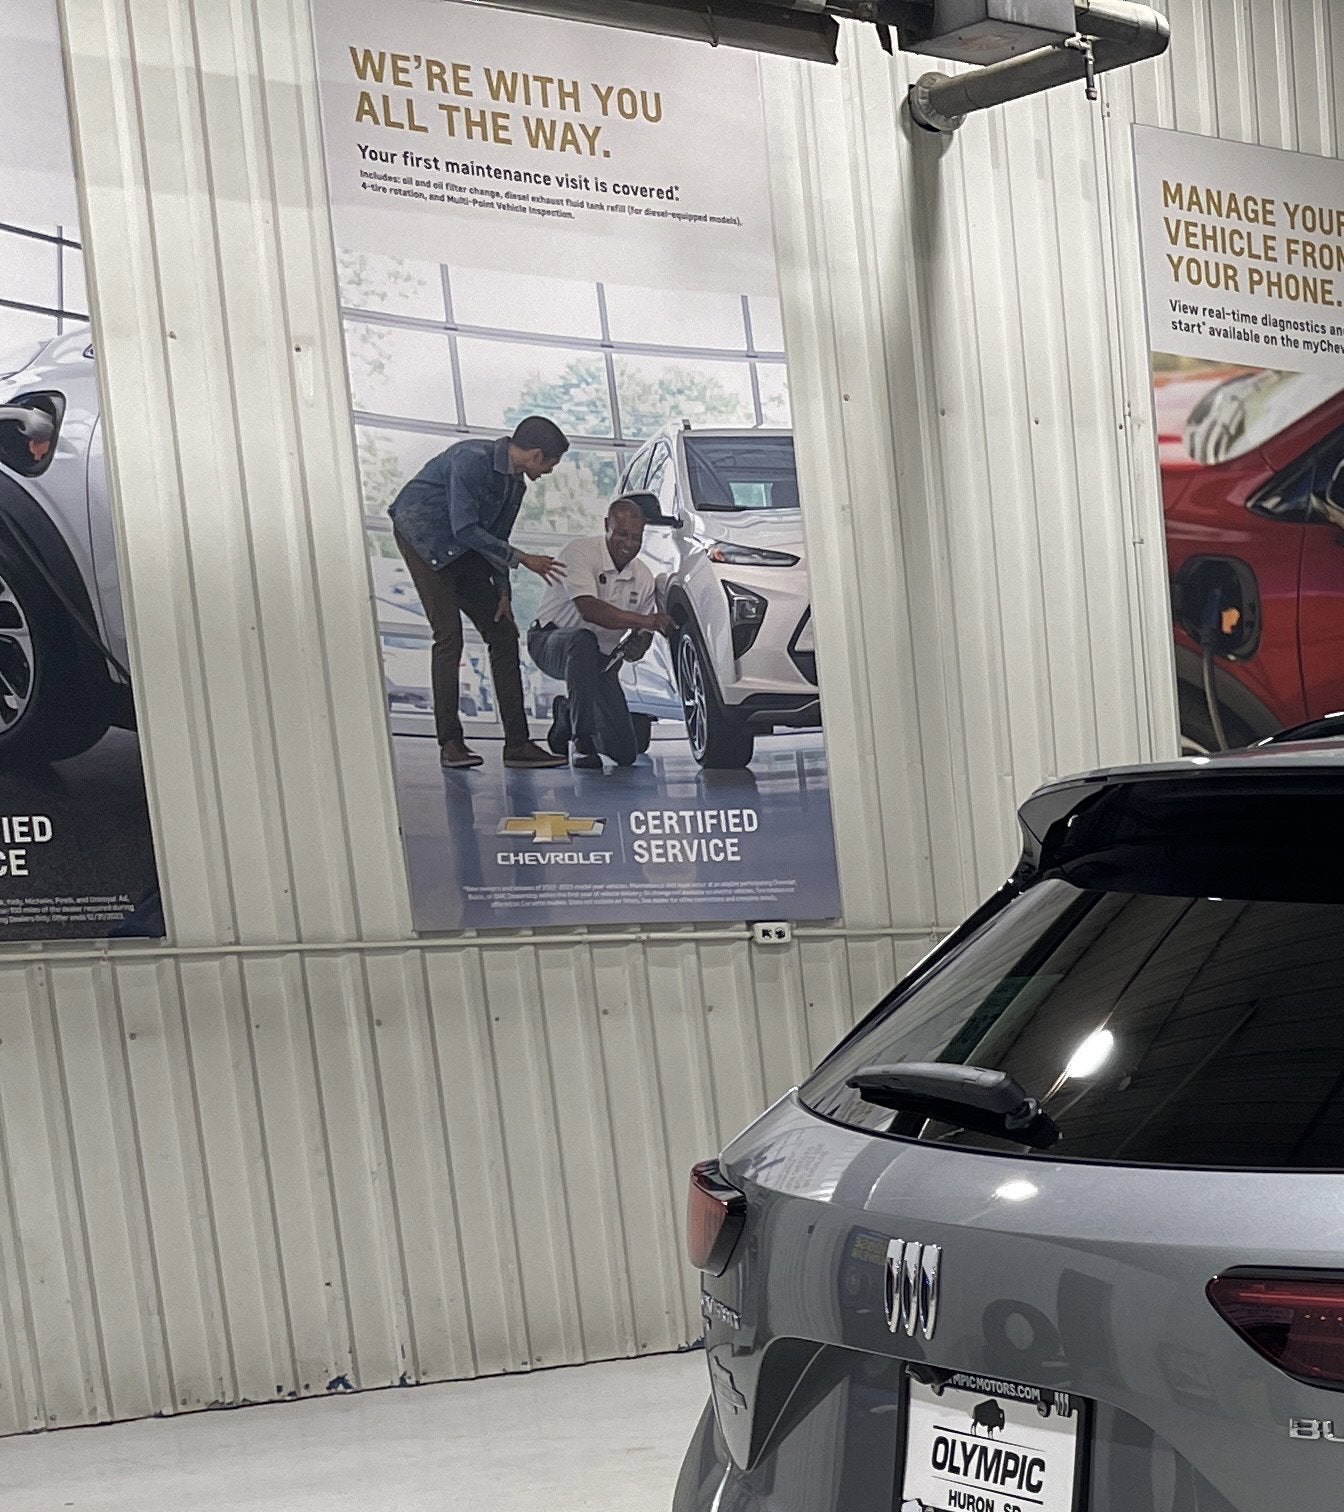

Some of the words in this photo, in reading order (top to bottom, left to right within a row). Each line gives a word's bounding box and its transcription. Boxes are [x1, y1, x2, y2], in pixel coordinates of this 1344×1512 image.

[349, 46, 474, 97] WE'RE
[483, 67, 581, 112] WITH
[591, 83, 662, 123] YOU
[355, 91, 429, 133] ALL
[438, 103, 512, 145] THE
[522, 116, 611, 158] WAY.
[357, 143, 398, 164] Your
[402, 151, 441, 171] first
[445, 161, 551, 186] maintenance
[555, 174, 590, 192] visit
[594, 177, 608, 193] is
[359, 169, 400, 183] Includes:
[402, 177, 413, 185] oil
[415, 180, 431, 188] and
[433, 182, 443, 190] oil
[445, 182, 467, 193] filter
[361, 182, 387, 194] 4-tire
[389, 188, 427, 201] rotation,
[496, 202, 527, 213] Vehicle
[1162, 179, 1276, 228] MANAGE
[1163, 216, 1278, 263] VEHICLE
[1166, 253, 1240, 293] YOUR
[1248, 267, 1343, 307] PHONE.
[1169, 299, 1199, 316] View
[1202, 306, 1258, 325] real-time
[1261, 313, 1327, 335] diagnostics
[1208, 325, 1260, 343] available
[1264, 334, 1278, 346] on
[1280, 334, 1299, 350] the
[629, 808, 759, 836] CERTIFIED
[496, 851, 613, 866] CHEVROLET
[632, 838, 741, 864] SERVICE
[948, 1373, 1041, 1401] MPICMOTORS.COM
[931, 1435, 1046, 1494] OLYMPIC
